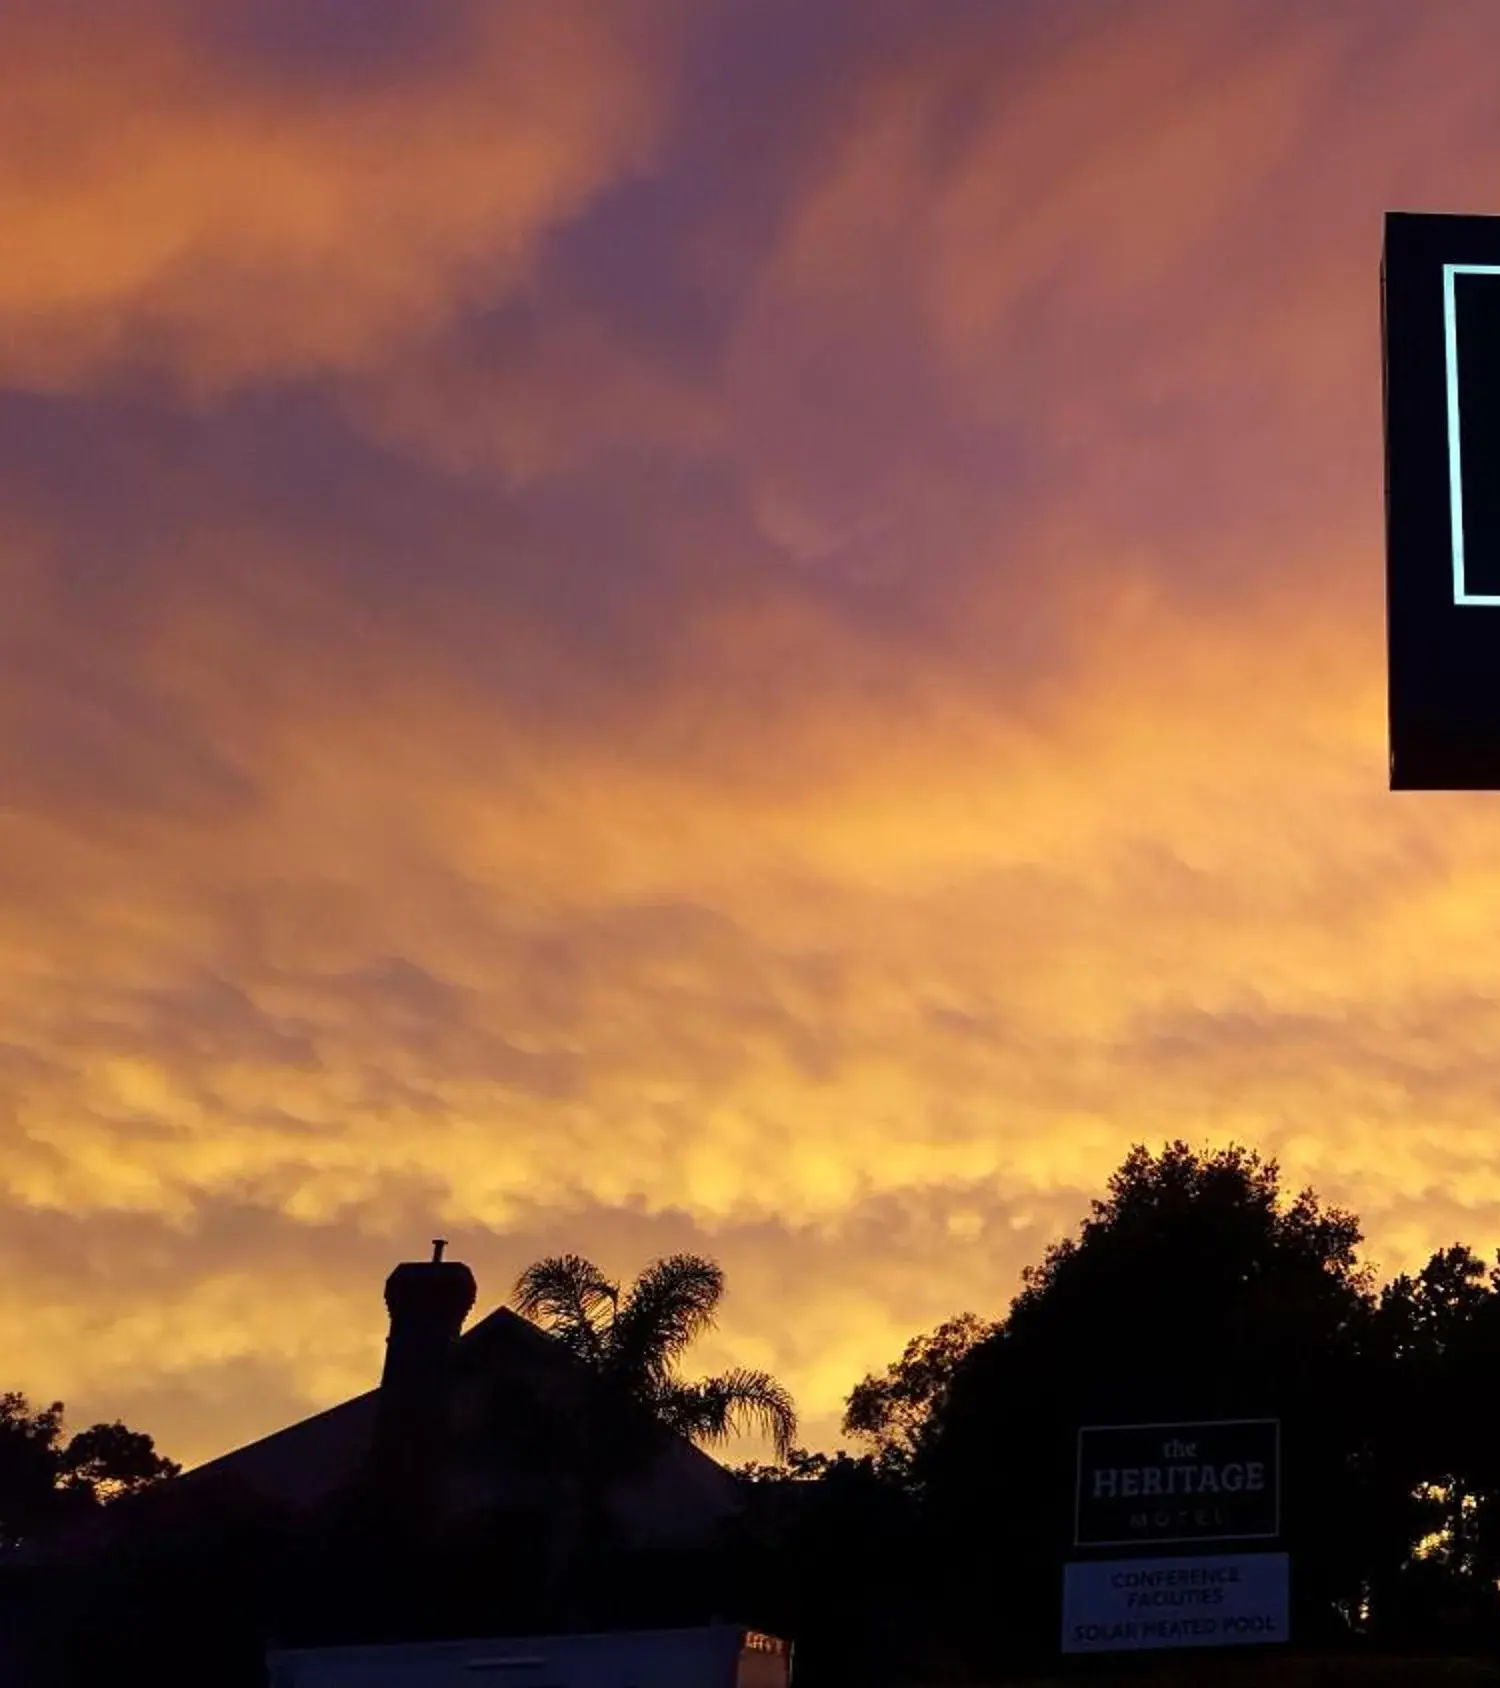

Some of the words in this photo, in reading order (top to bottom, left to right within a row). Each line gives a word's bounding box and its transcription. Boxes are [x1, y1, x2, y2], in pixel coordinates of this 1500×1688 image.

[1163, 1438, 1198, 1459] the
[1092, 1461, 1266, 1498] HERITAGE
[1110, 1567, 1242, 1588] CONFERENCE
[1128, 1587, 1224, 1608] FACILITIES
[1222, 1615, 1276, 1633] POOL
